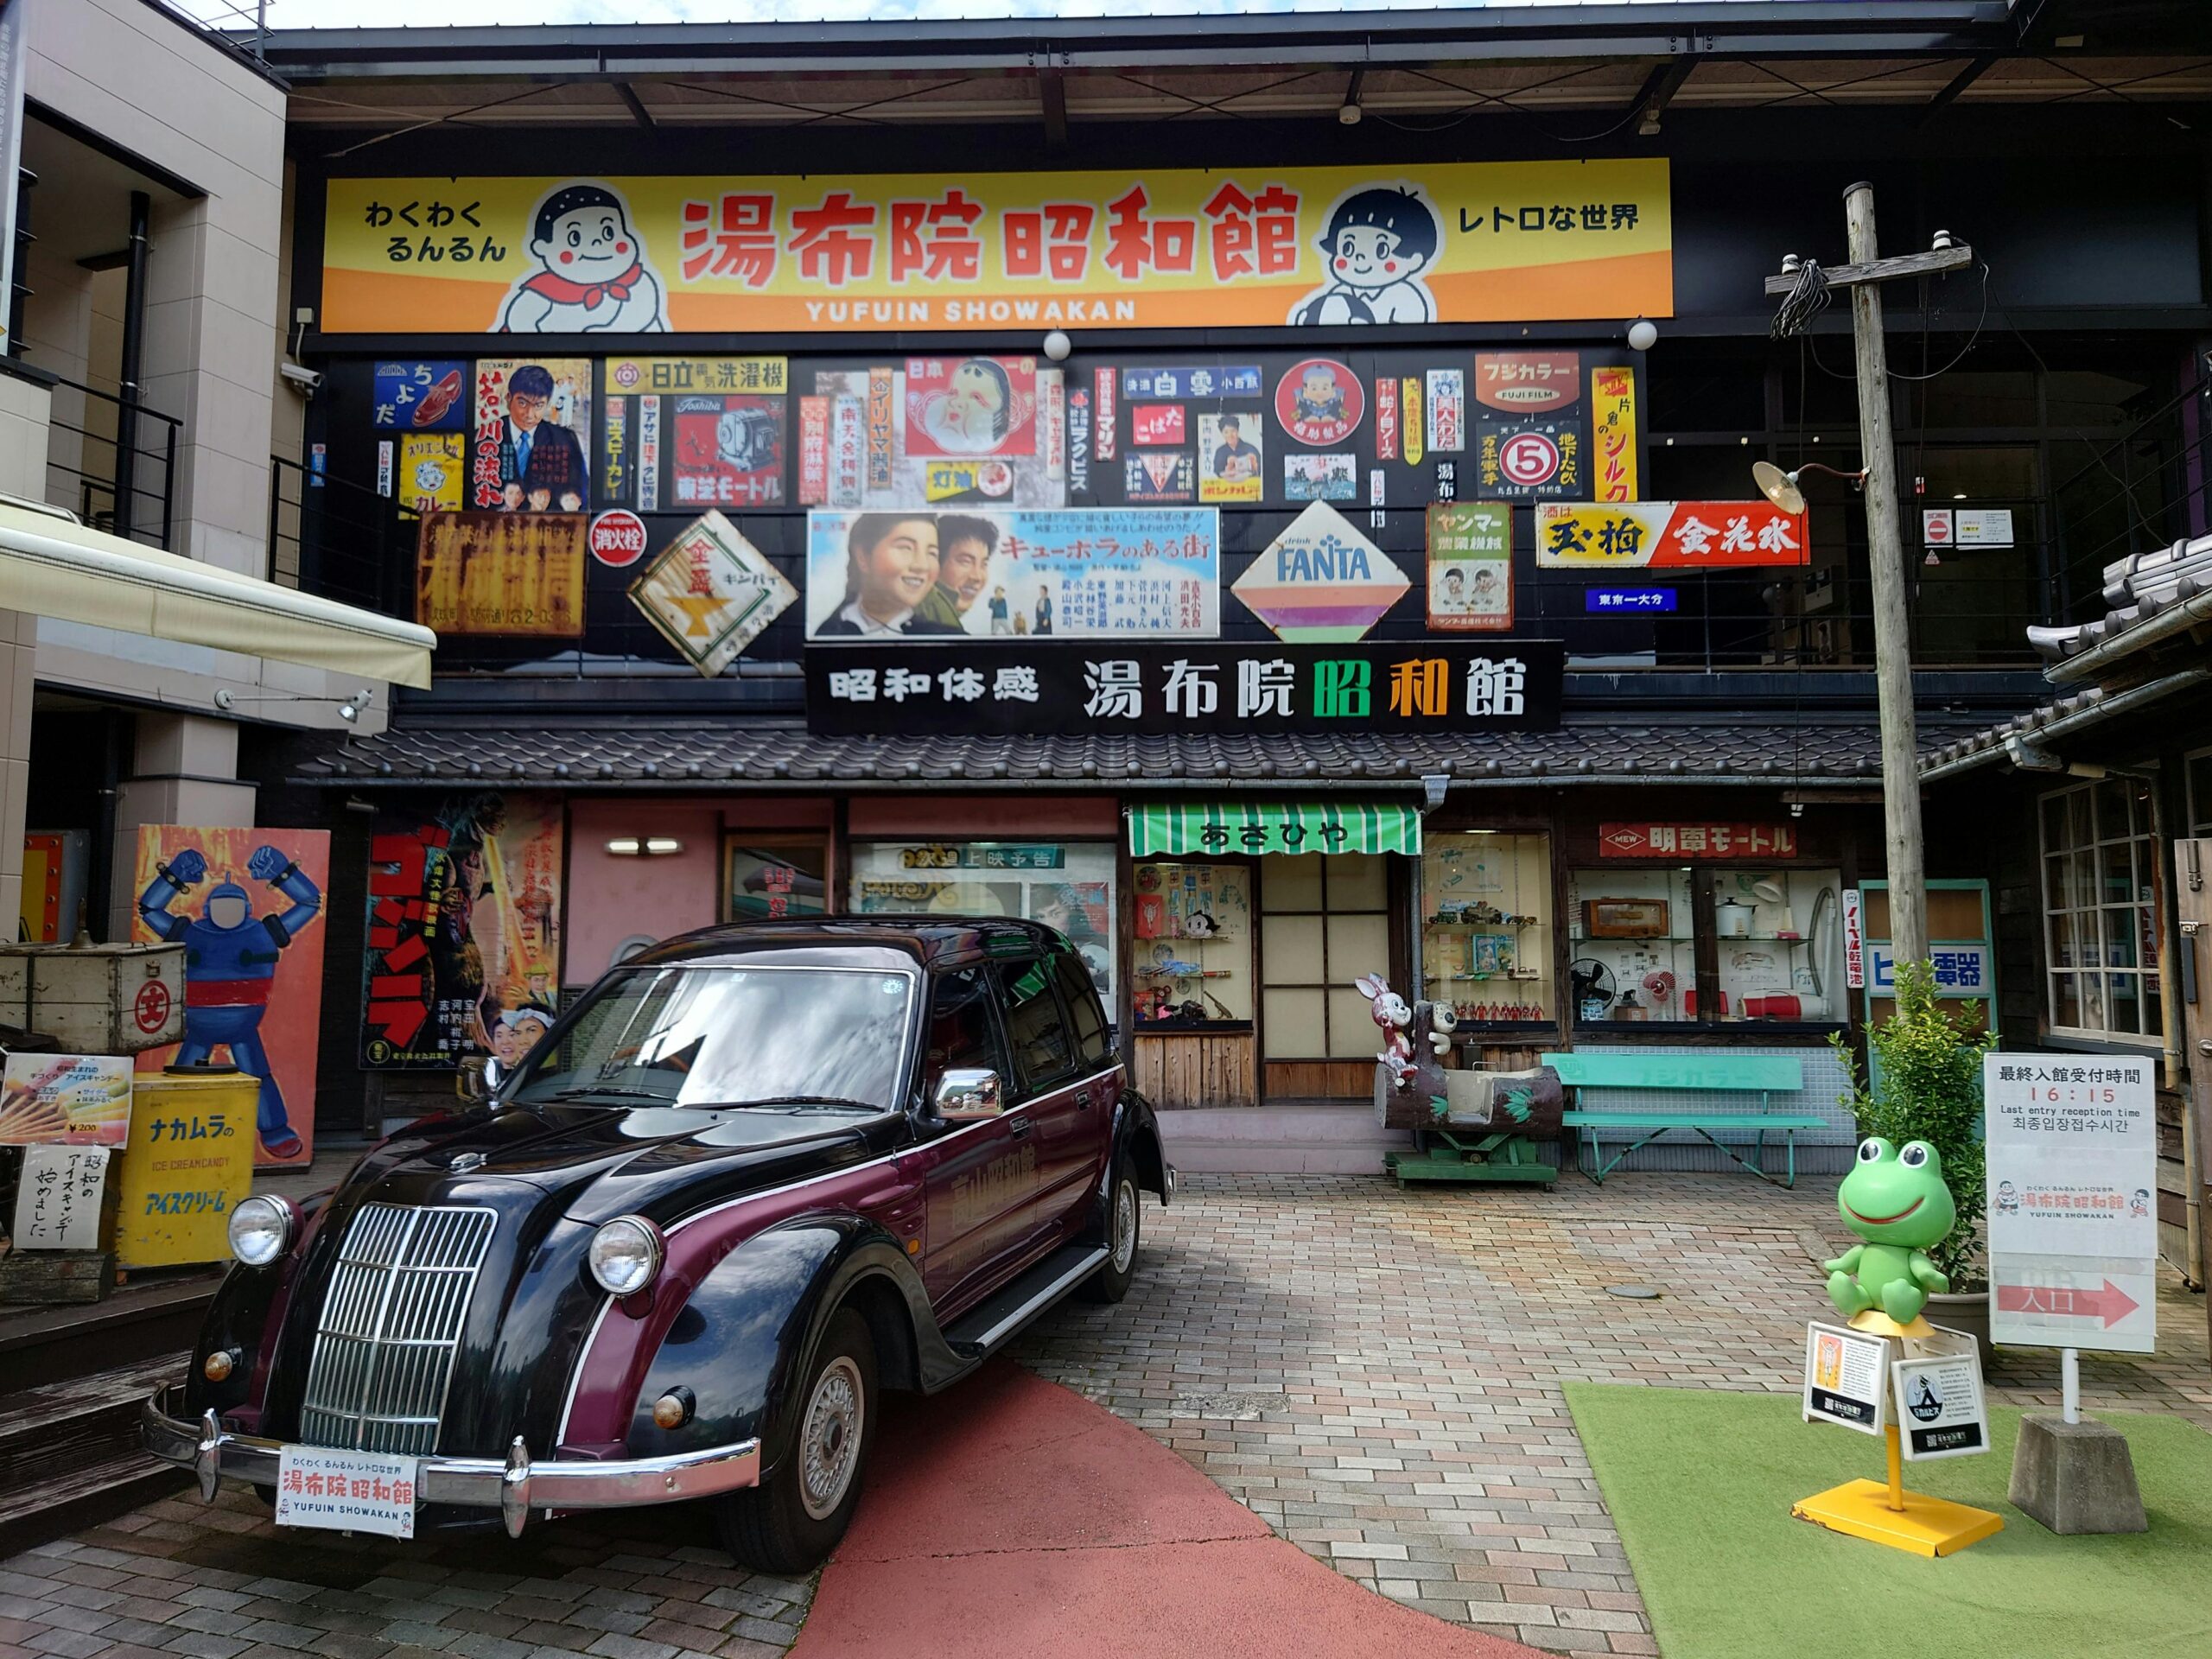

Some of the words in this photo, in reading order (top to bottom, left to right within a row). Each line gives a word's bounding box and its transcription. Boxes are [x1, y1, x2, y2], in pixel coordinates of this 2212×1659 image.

[364, 200, 481, 228] わくわく
[1459, 203, 1640, 234] レトロな世界
[681, 182, 1300, 286] 湯布院昭和館
[386, 233, 506, 262] るんるん
[804, 301, 929, 324] YUFUIN
[944, 299, 1136, 323] SHOWAKAN
[1484, 362, 1571, 382] フジカラー
[677, 398, 721, 414] Toshiba
[1528, 391, 1554, 399] FILM
[474, 370, 504, 509] 若い川の流れ
[1558, 432, 1578, 485] 地下たび
[1604, 433, 1629, 502] シルク
[677, 476, 782, 501] 東芝モートル
[1437, 462, 1454, 503] 湯布
[1437, 513, 1503, 533] ヤンマー
[1543, 505, 1573, 518] 酒は
[594, 527, 642, 551] 消火栓
[1284, 537, 1312, 545] drink
[1276, 543, 1372, 582] FANTA
[829, 666, 1039, 703] 昭和体感
[1083, 657, 1526, 719] 湯布院昭和館
[1199, 821, 1348, 846] あさひや
[1614, 835, 1638, 844] MEW
[1649, 825, 1793, 854] 明電モートル
[1847, 906, 1863, 985] ノーベル乾電池
[1999, 1065, 2141, 1084] 最終入館受付時間
[2031, 1087, 2115, 1103] 16:15
[2000, 1105, 2024, 1115] Last
[2028, 1107, 2056, 1116] entry
[2062, 1107, 2113, 1119] reception
[2117, 1108, 2140, 1117] time
[149, 1115, 234, 1142] ナカムラの
[2012, 1116, 2129, 1134] 최종입장접수시간
[152, 1160, 168, 1172] ICE
[29, 1167, 58, 1237] 始めました
[55, 1154, 81, 1242] アイスキャンデー
[145, 1190, 226, 1216] アイスクリーム
[2020, 1192, 2124, 1210] 湯布院昭和館
[2019, 1287, 2075, 1313] 入口
[292, 1457, 321, 1468] わくわく
[324, 1459, 354, 1471] るんるん
[357, 1462, 402, 1476] レトロな世界
[283, 1469, 413, 1505] 湯布院昭和館
[293, 1501, 334, 1513] YUFUIN
[339, 1504, 399, 1521] SHOWAKAN
